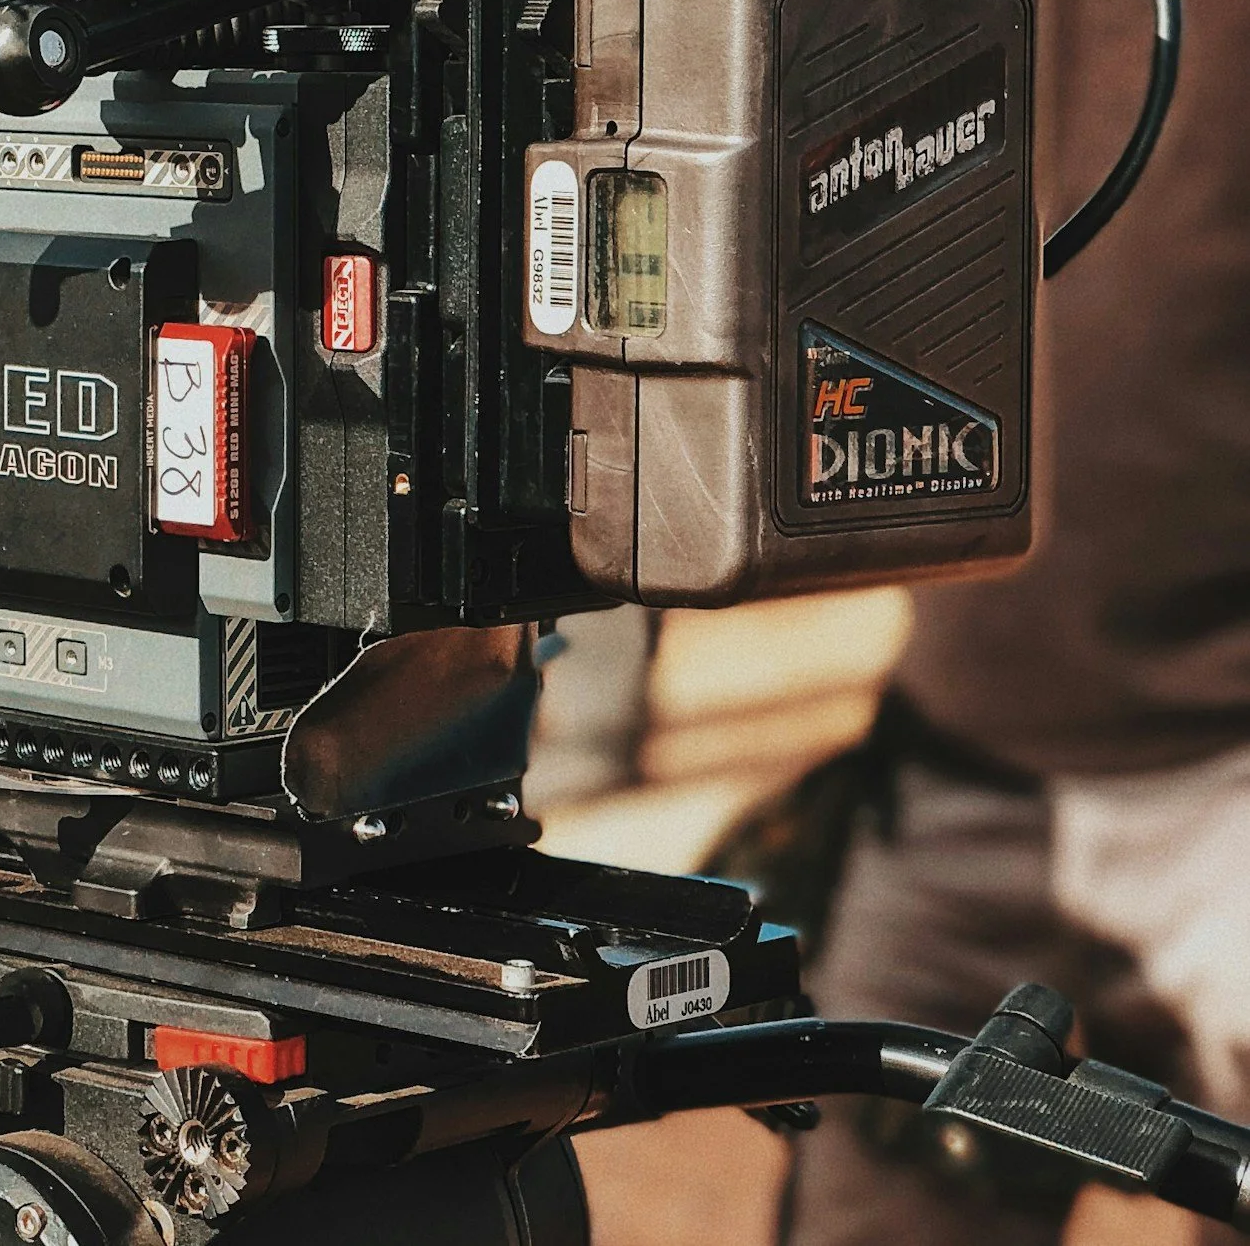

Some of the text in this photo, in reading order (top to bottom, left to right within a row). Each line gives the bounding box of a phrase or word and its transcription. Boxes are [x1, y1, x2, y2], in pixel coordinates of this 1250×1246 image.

[533, 193, 548, 305] Abel G9832
[813, 378, 874, 423] HC
[146, 394, 155, 467] INSERT MEDIA
[229, 432, 240, 462] RED
[98, 656, 114, 671] M3
[645, 996, 713, 1025] Abel J0430
